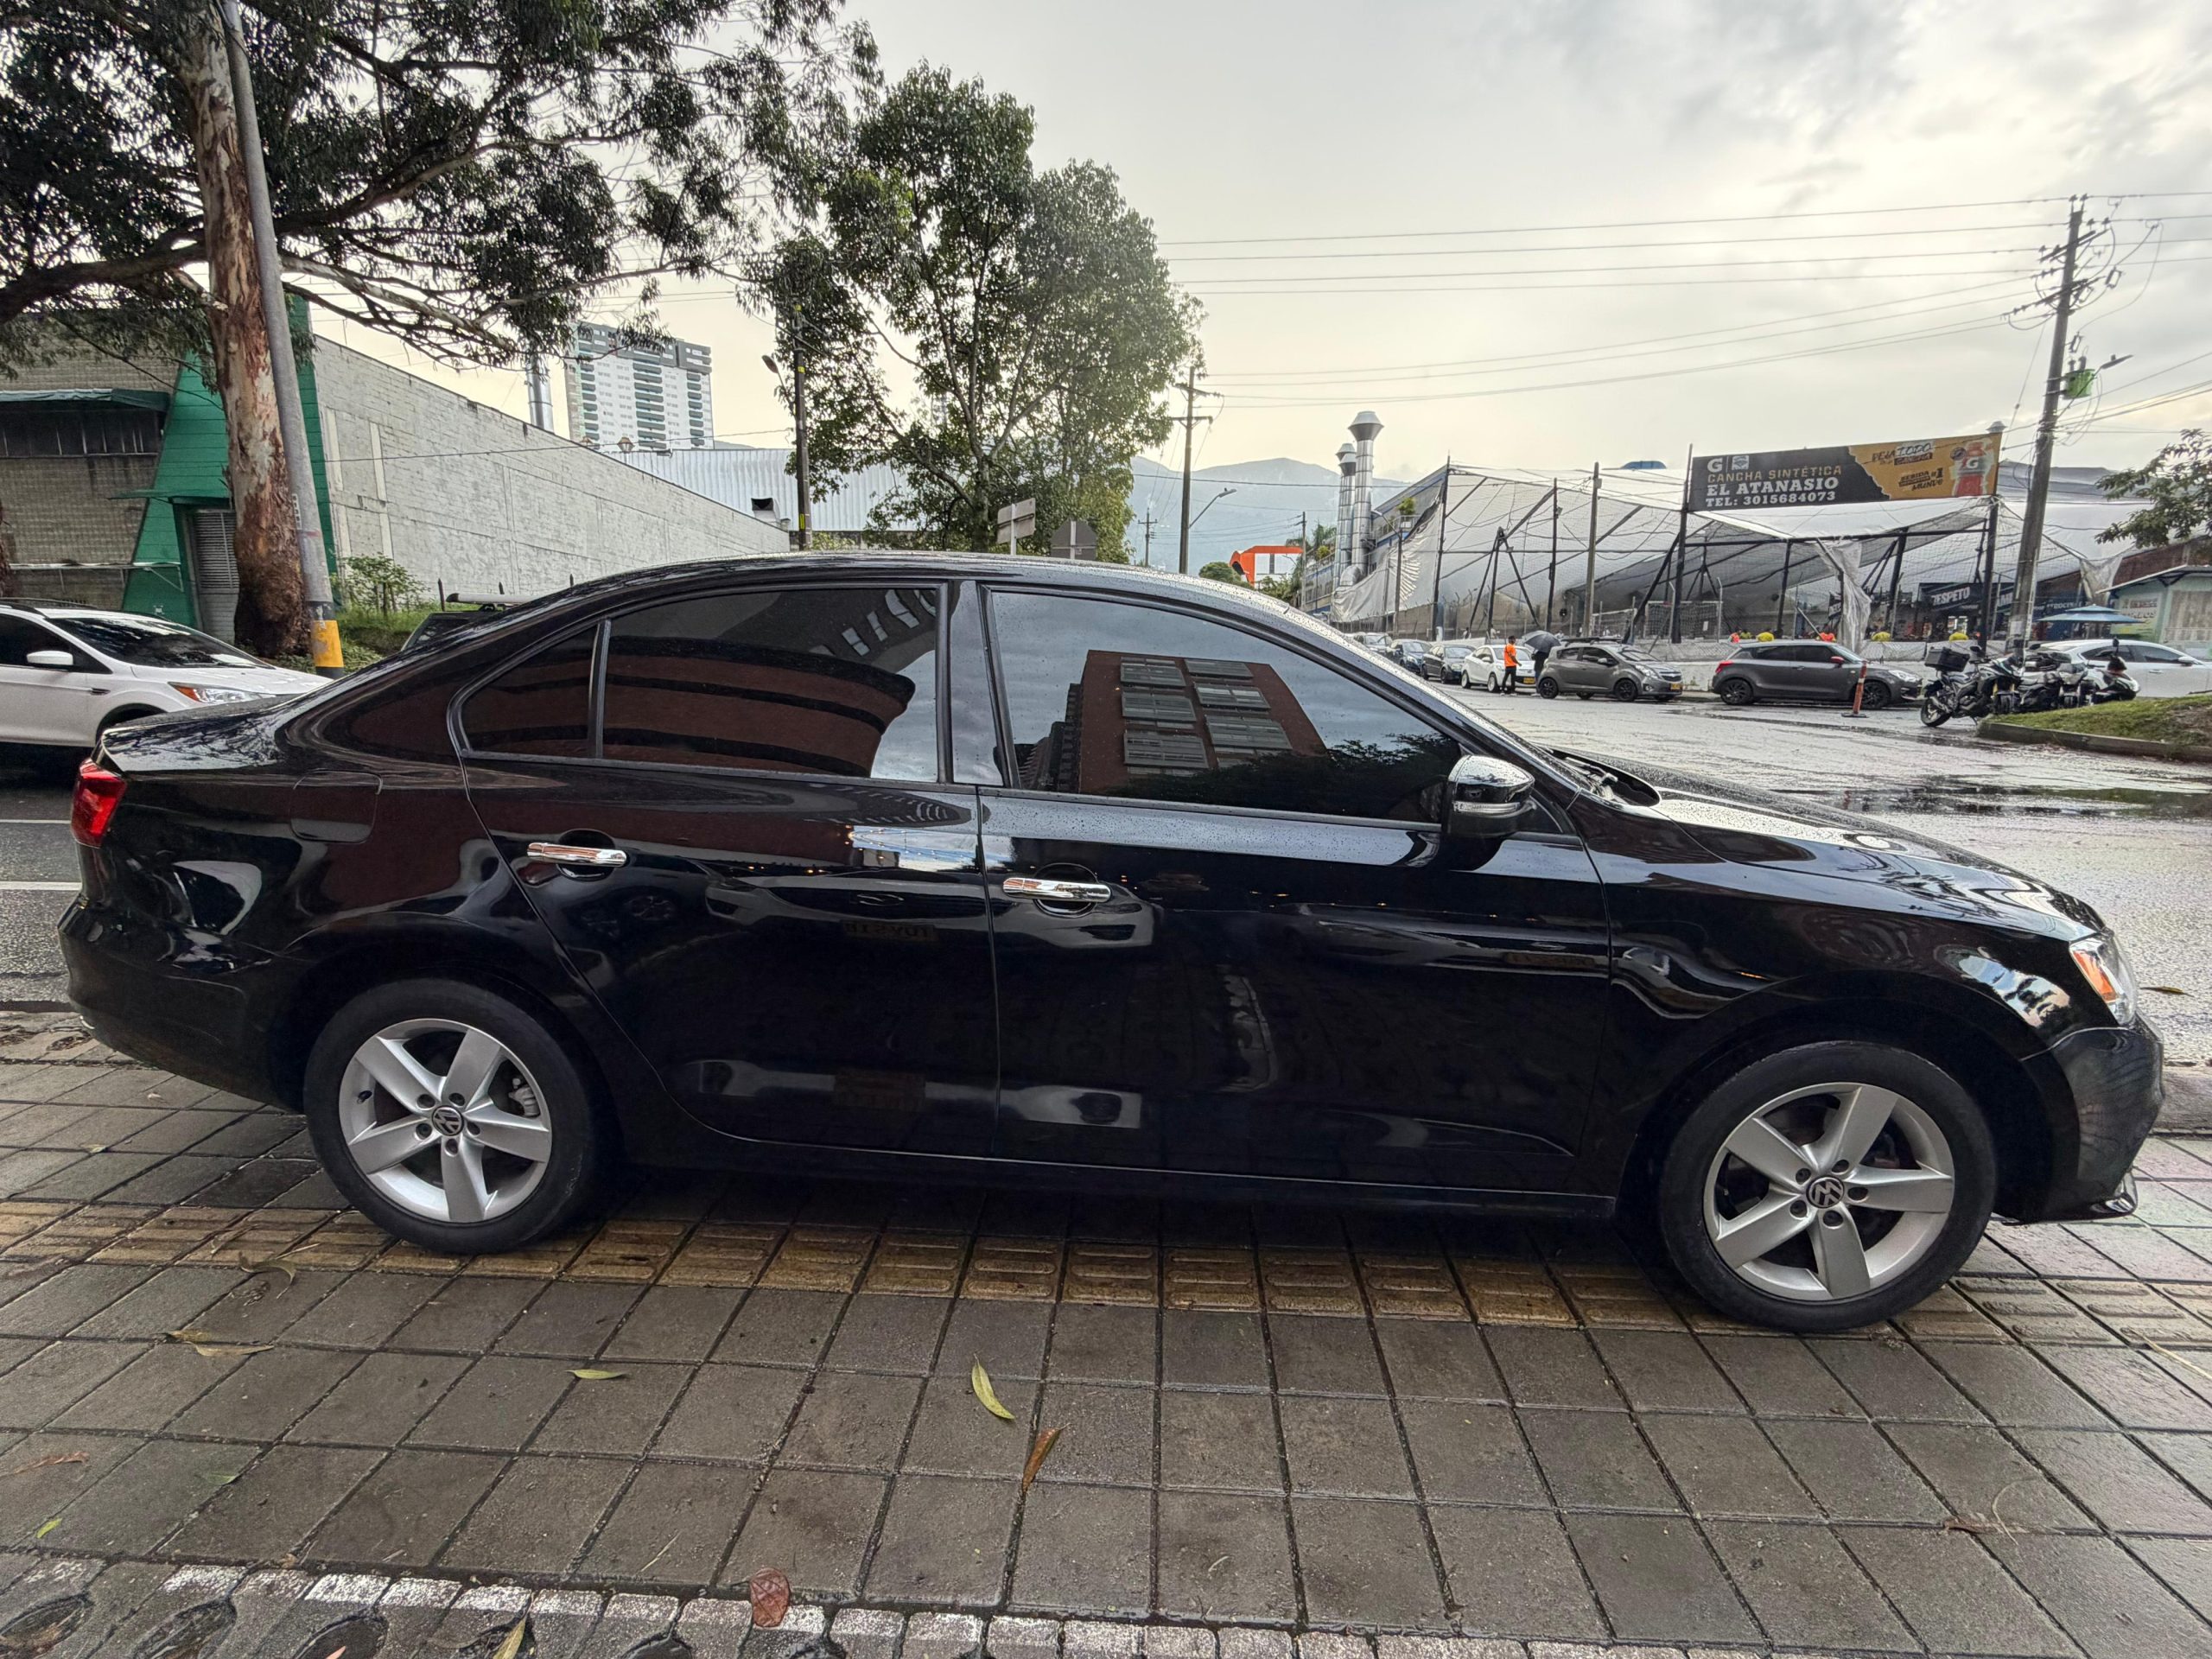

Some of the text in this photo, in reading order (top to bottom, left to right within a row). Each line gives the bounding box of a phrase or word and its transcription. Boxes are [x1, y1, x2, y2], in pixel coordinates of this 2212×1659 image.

[1707, 458, 1723, 473] G
[1707, 465, 1842, 484] CANCHA SINTÉTICA
[1707, 476, 1840, 497] EL ATANASIO
[1706, 491, 1836, 508] TEL: 3015684073
